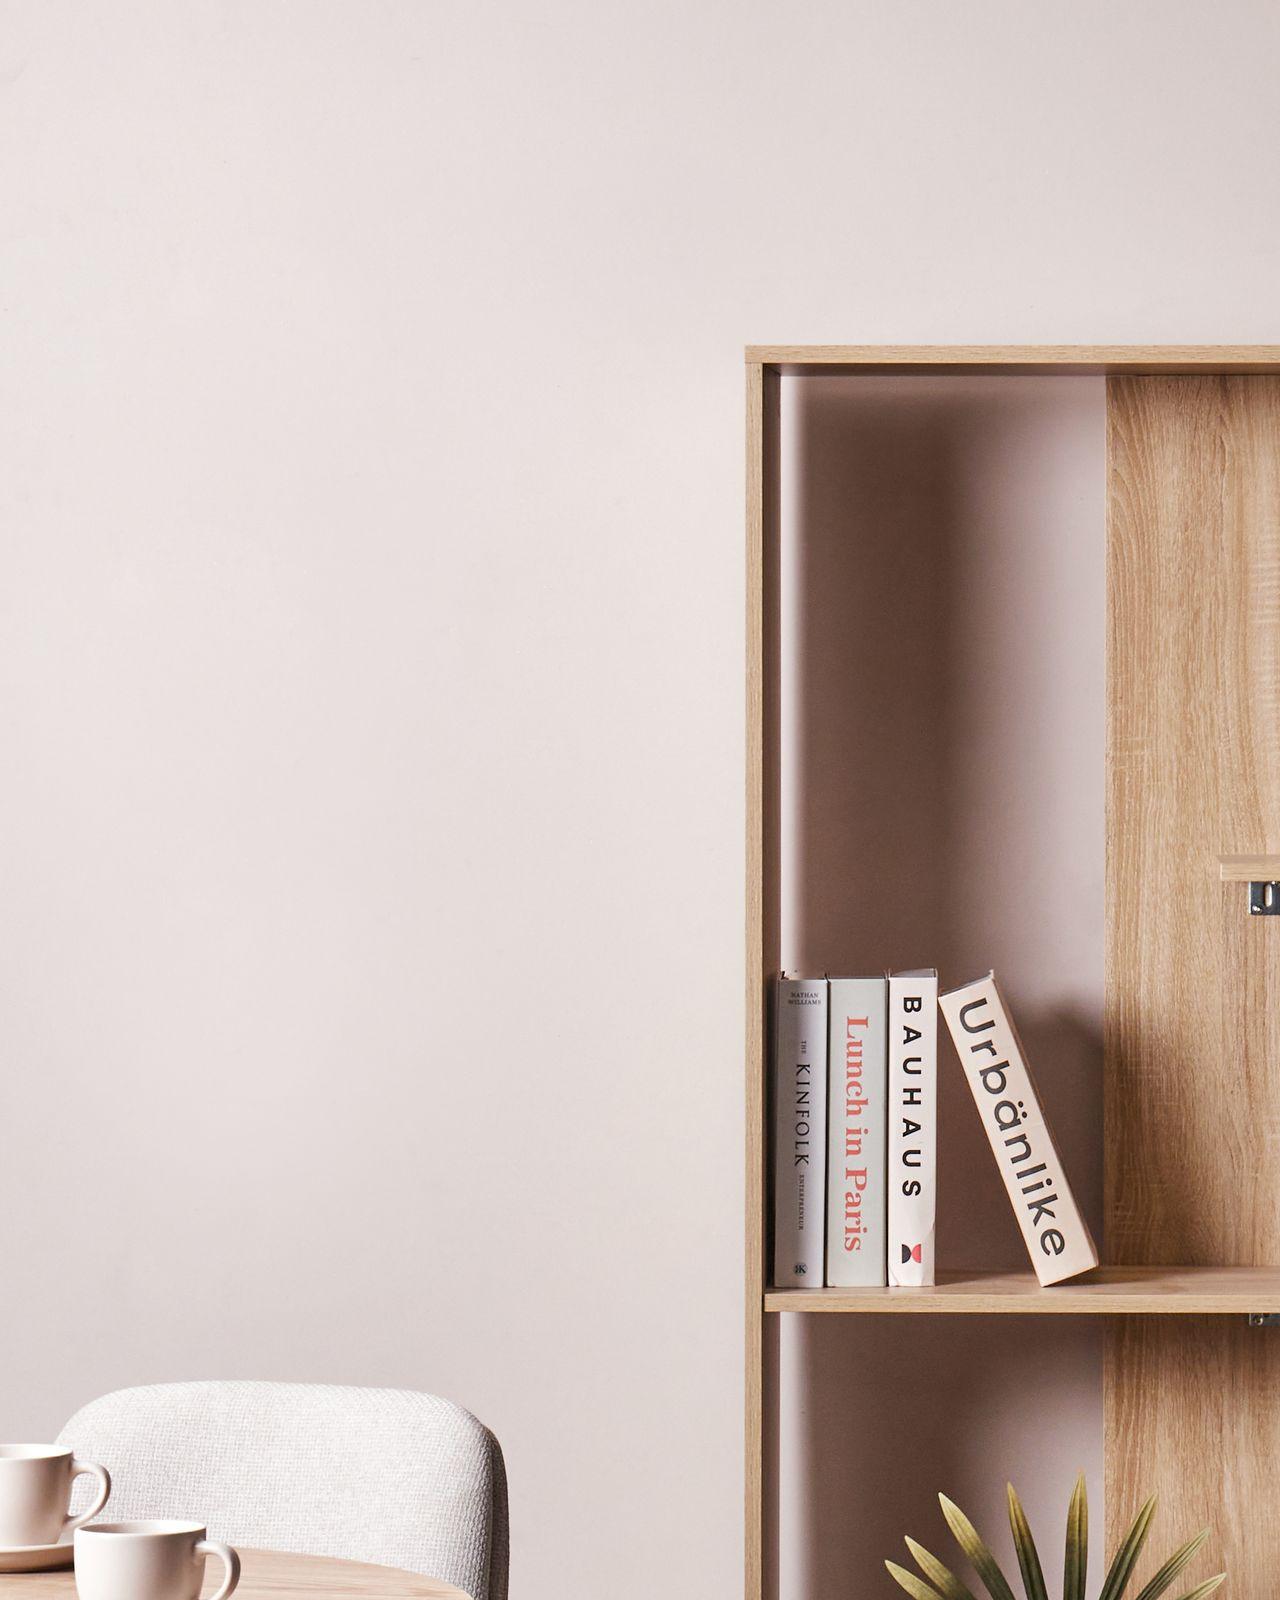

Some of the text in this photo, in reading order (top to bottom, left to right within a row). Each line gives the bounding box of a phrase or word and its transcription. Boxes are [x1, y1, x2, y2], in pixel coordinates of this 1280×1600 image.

[790, 991, 819, 999] NATHAN
[794, 1063, 811, 1167] KINFOLK
[844, 1016, 869, 1253] Lunch in Paris
[902, 996, 922, 1197] BAUHAUS
[959, 997, 1065, 1256] Urbänlike
